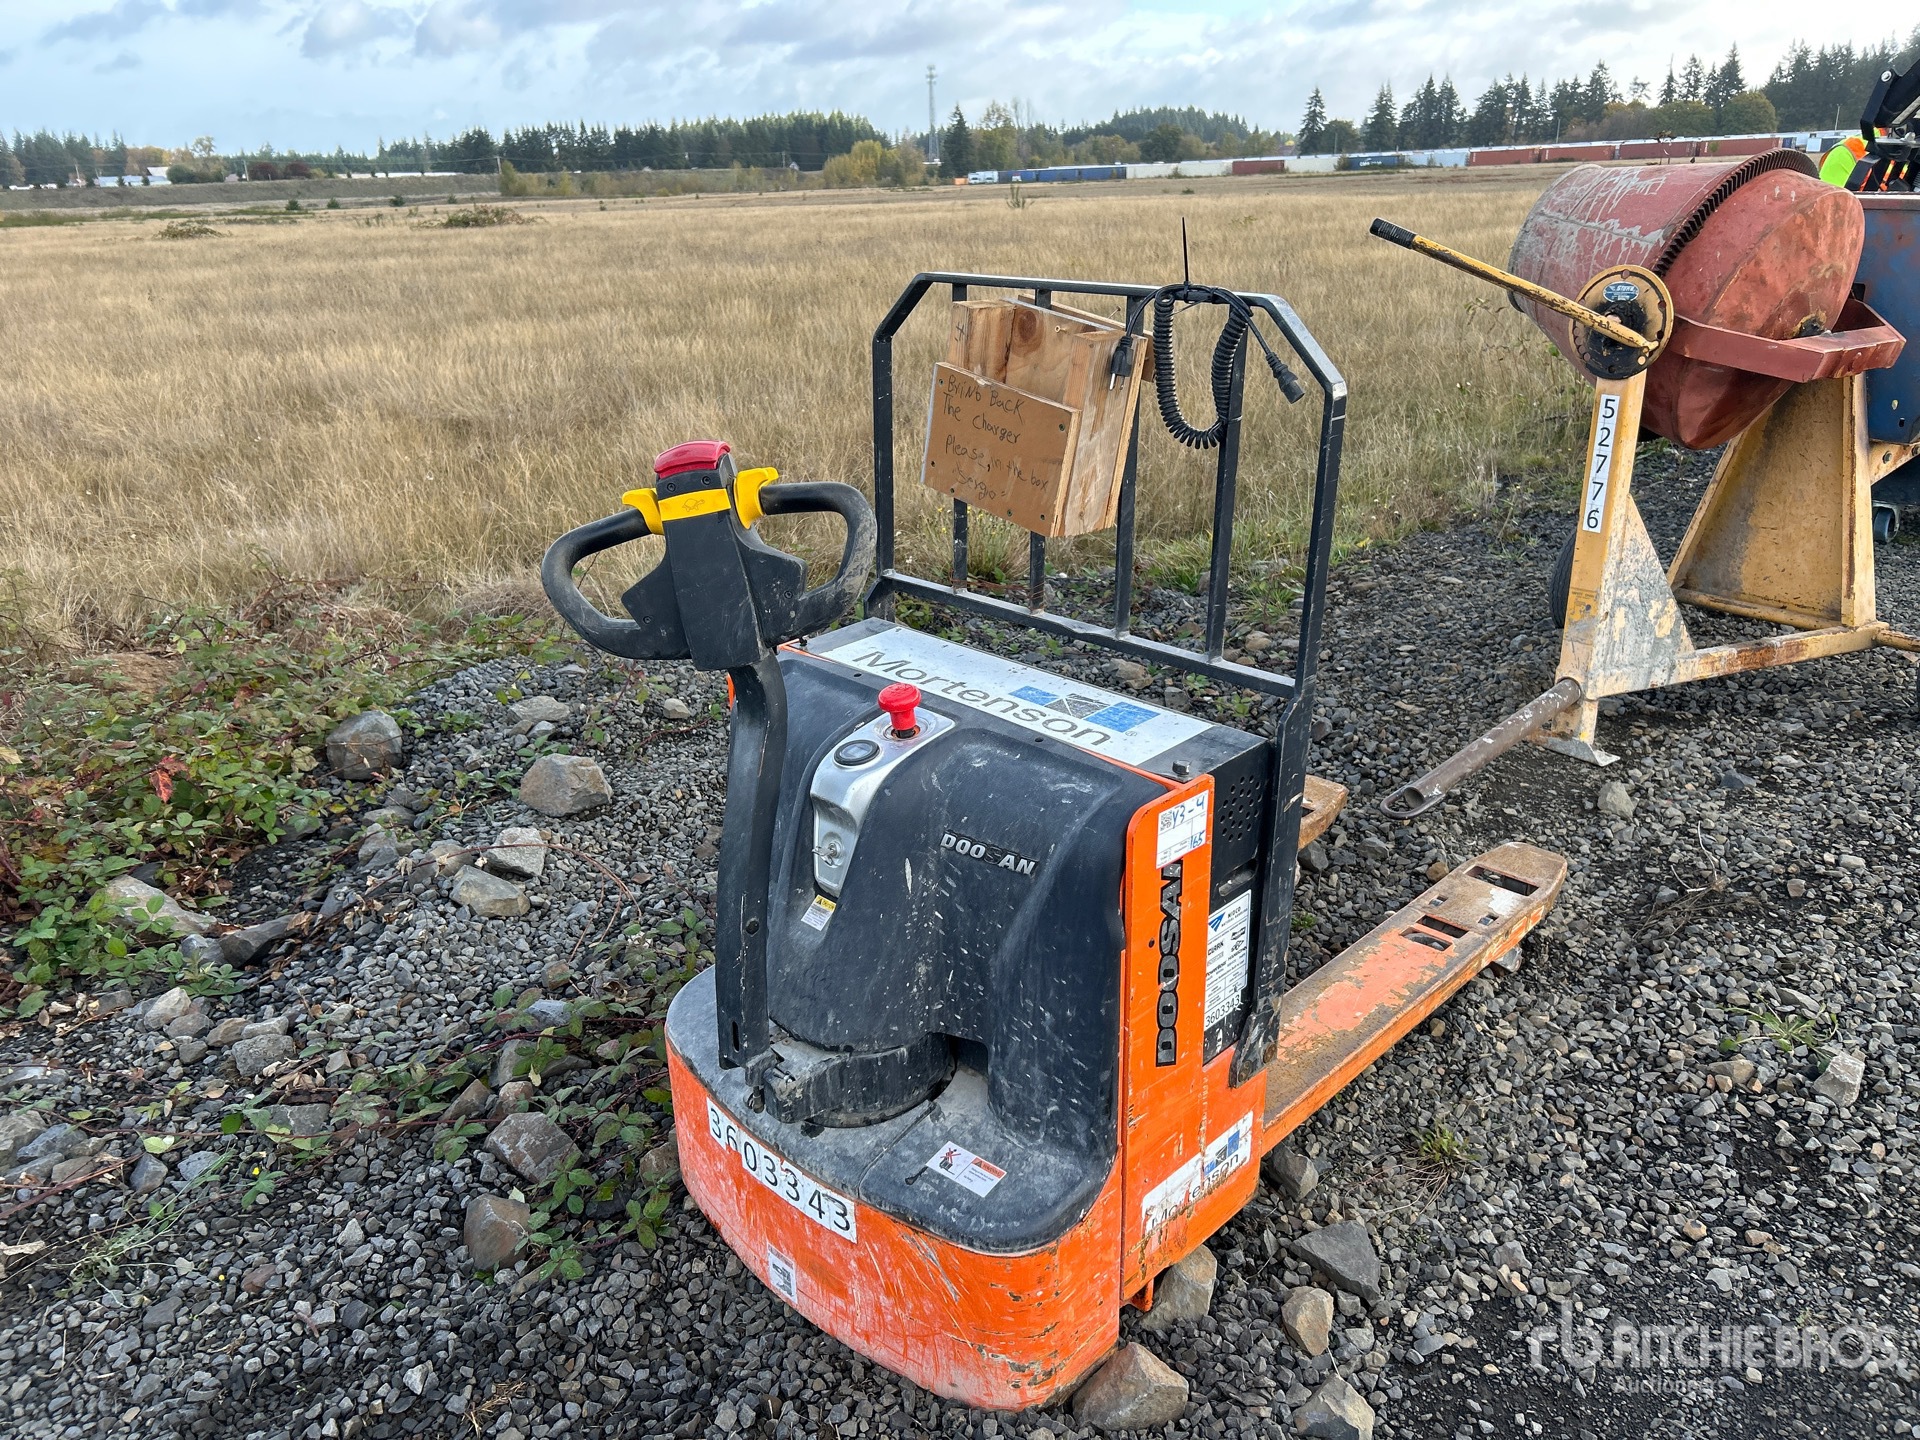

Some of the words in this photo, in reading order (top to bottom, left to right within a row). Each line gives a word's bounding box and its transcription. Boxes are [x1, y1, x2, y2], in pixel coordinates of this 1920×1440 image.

[943, 391, 962, 421] The
[972, 413, 1021, 444] Charger
[1030, 468, 1049, 491] box
[1586, 398, 1616, 529] 52776
[852, 650, 1112, 747] Mortenson
[940, 832, 1036, 876] DOOSAN
[1205, 994, 1241, 1027] 3603343
[710, 1107, 851, 1232] 3603343
